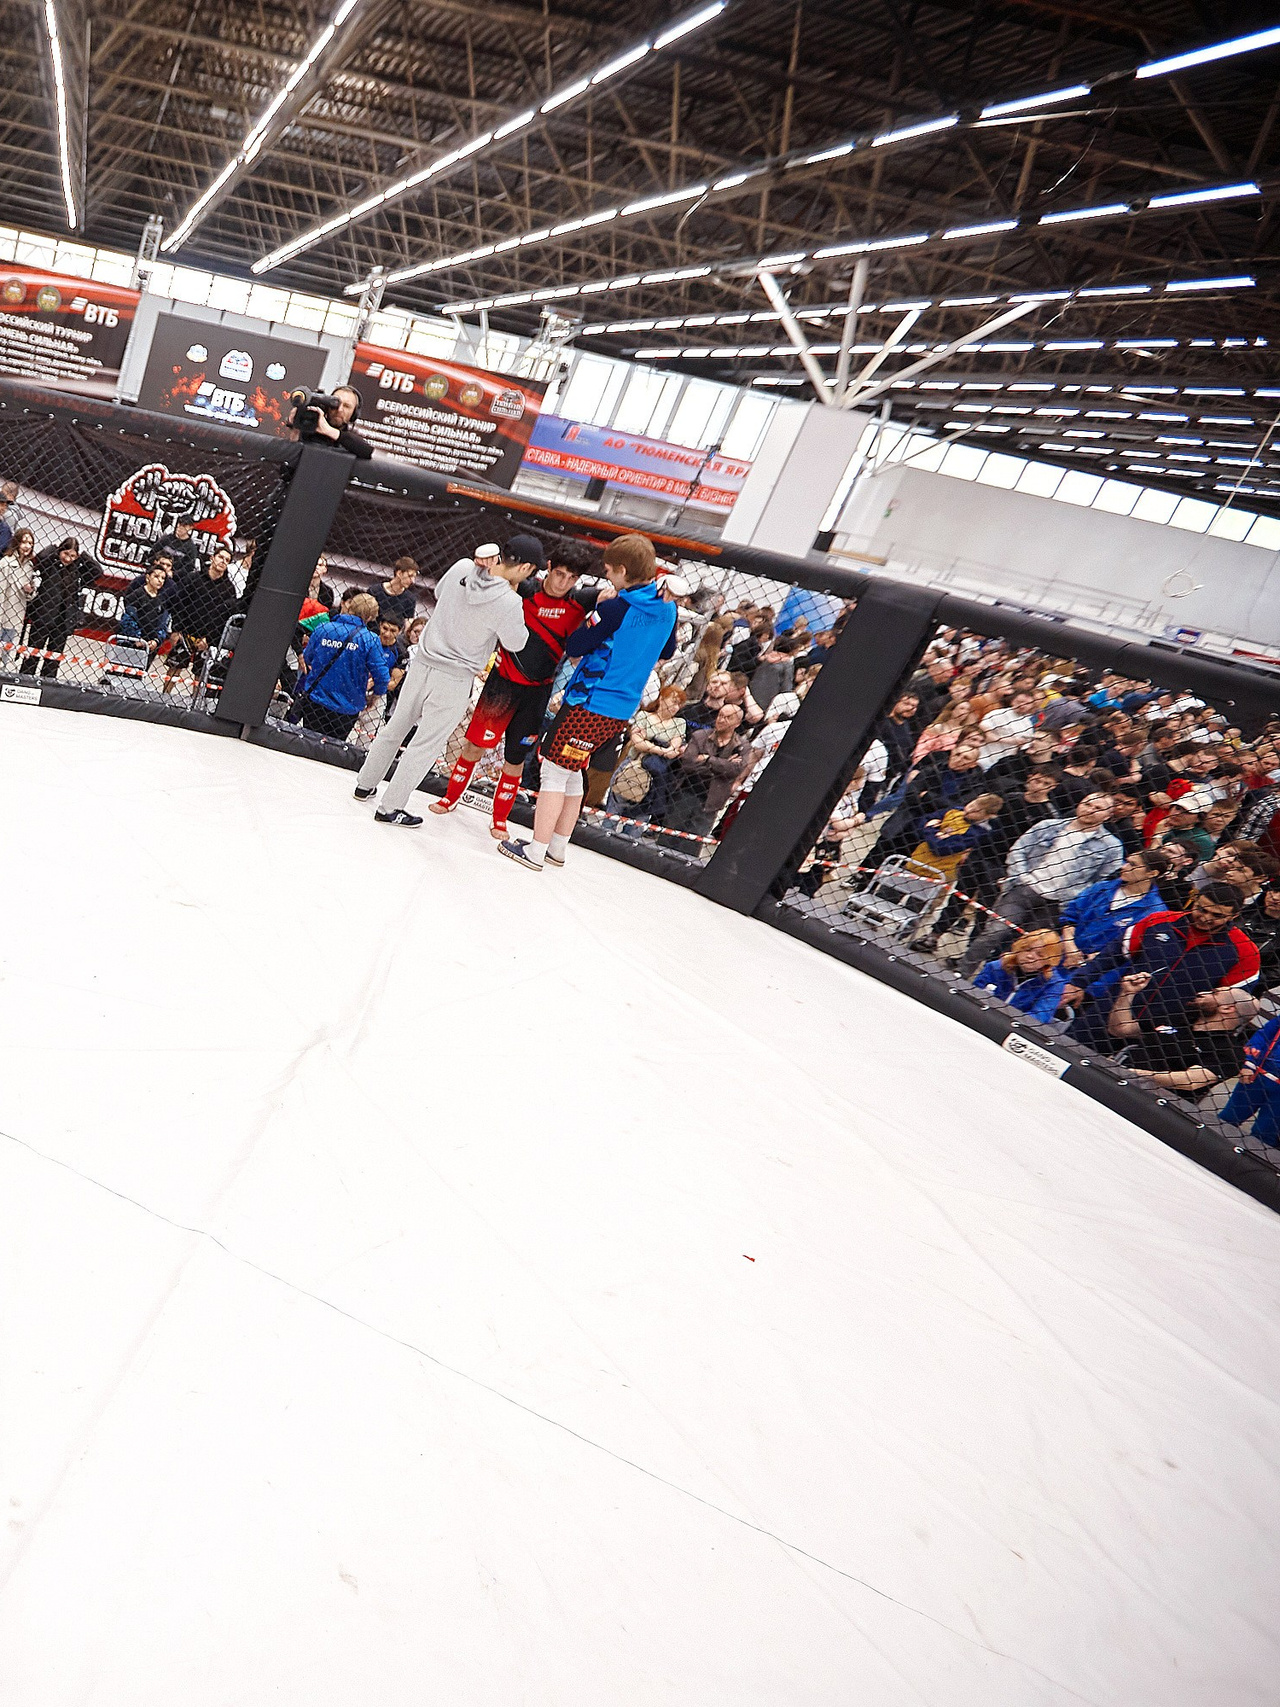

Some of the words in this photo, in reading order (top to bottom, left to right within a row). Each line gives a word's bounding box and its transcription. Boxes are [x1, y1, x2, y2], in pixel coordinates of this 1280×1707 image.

[83, 303, 120, 329] ВТБ
[54, 326, 93, 342] ТУРНИР
[379, 368, 416, 394] ВТБ
[211, 388, 247, 412] ВТБ
[376, 399, 458, 425] ВСЕРОССИЙСКИЙ
[457, 417, 497, 433] ТУРНИР
[602, 435, 626, 450] АО
[566, 456, 618, 479] НАДЕЖНЫЙ
[618, 469, 666, 490] ОРИЕНТИР
[321, 638, 359, 651] ВОЛОТЕР
